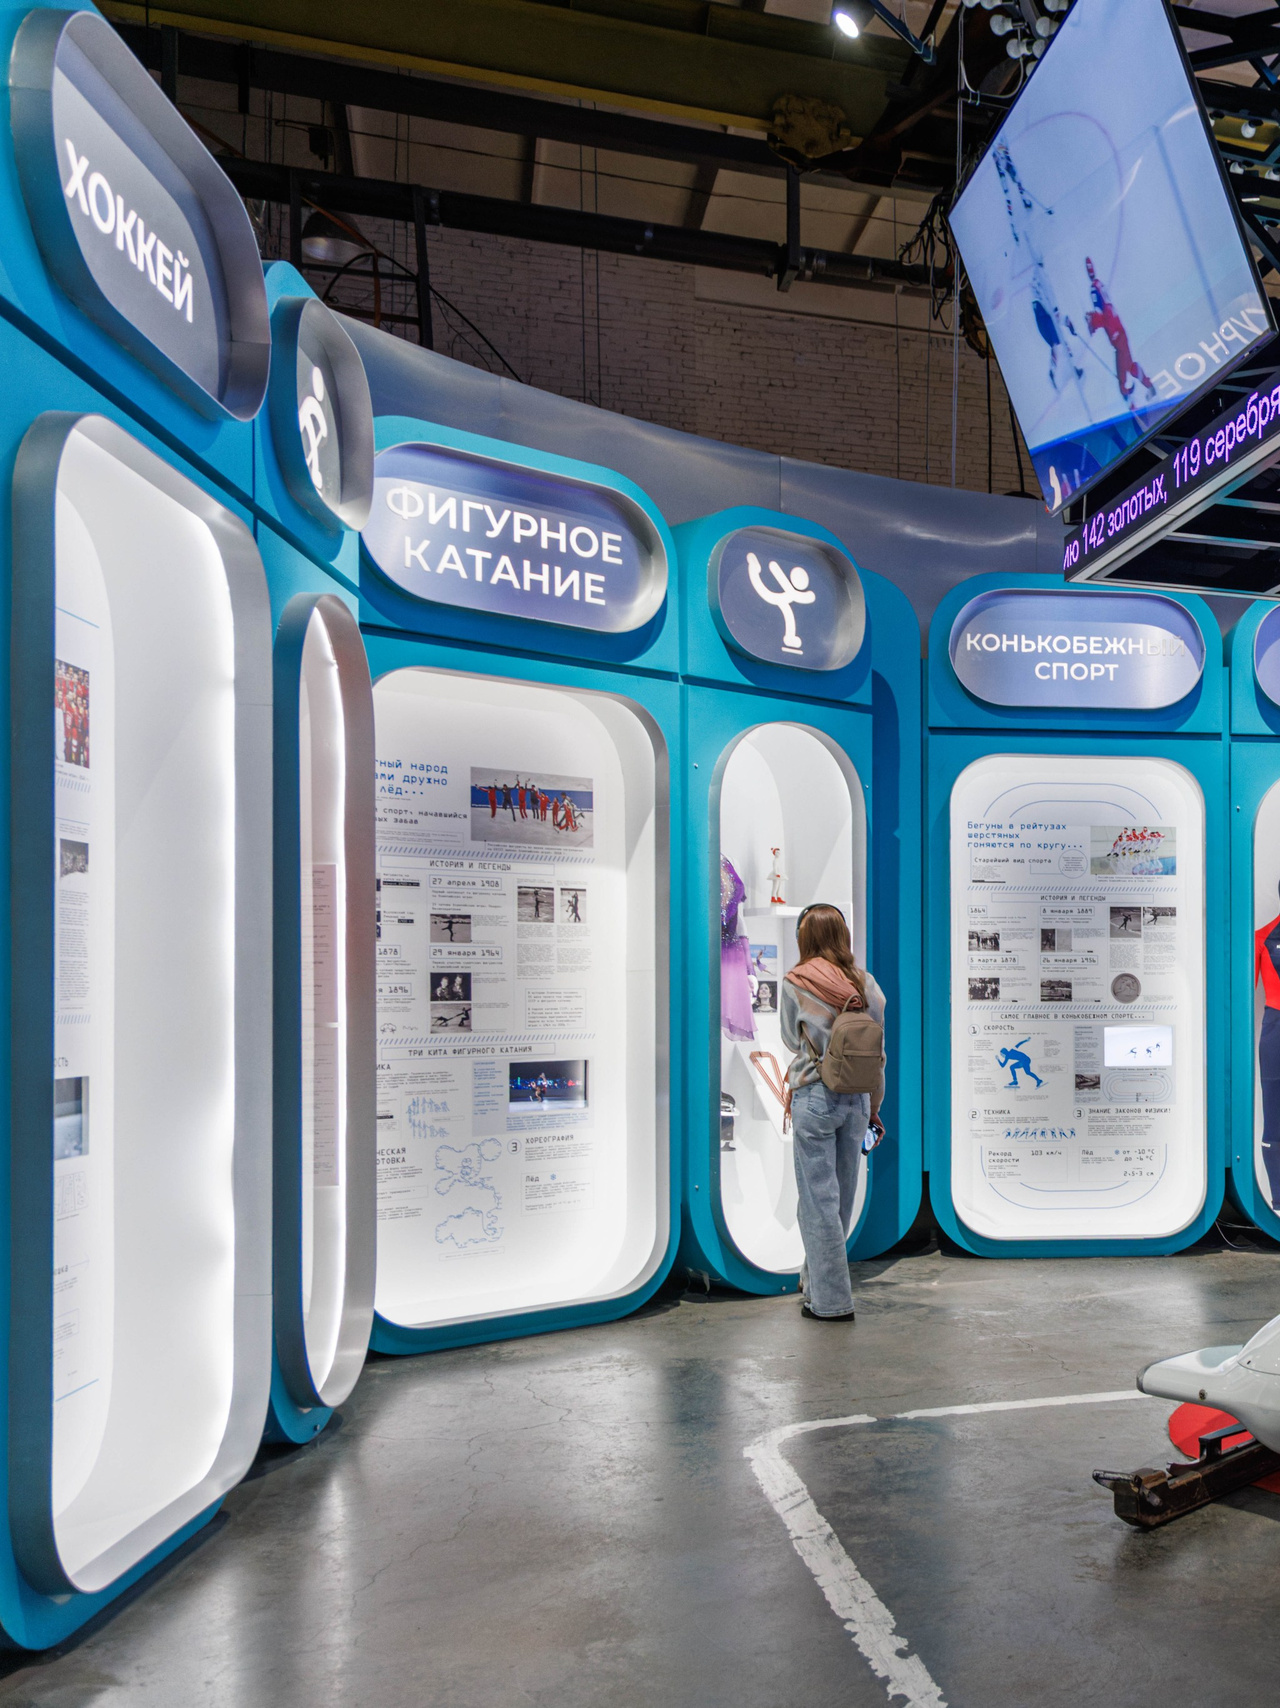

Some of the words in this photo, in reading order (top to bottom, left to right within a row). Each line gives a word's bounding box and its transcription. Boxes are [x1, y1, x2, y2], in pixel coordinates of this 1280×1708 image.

[65, 138, 193, 323] ХОККЕЙ
[1082, 512, 1105, 555] 142
[1107, 474, 1168, 539] золотых,
[1173, 439, 1201, 488] 119
[385, 486, 623, 565] ФИГУРНОЕ
[404, 536, 606, 605] КАТАНИЕ
[966, 632, 1186, 657] КОНЬКОБЕЖНЫЙ
[1034, 662, 1119, 681] СПОРТ
[411, 762, 448, 774] народ
[402, 775, 448, 786] дружно
[419, 811, 468, 819] начавшийся
[967, 821, 1003, 831] Бегуны
[1020, 823, 1067, 831] рейтузах
[430, 860, 464, 868] ИСТОРИЯ
[478, 862, 512, 871] ЛЕГЕНДЫ
[481, 879, 500, 888] 1908
[378, 948, 399, 956] 1878
[388, 986, 409, 994] 1896
[408, 1049, 423, 1057] ТРИ
[452, 1046, 496, 1056] ФИГУРНОГО
[500, 1046, 533, 1054] КАТАНИЯ
[1076, 1110, 1082, 1118] 3
[525, 1135, 574, 1144] ХОРЕОГРАФИЯ
[511, 1142, 518, 1152] 3
[988, 1150, 1012, 1158] Рекорд
